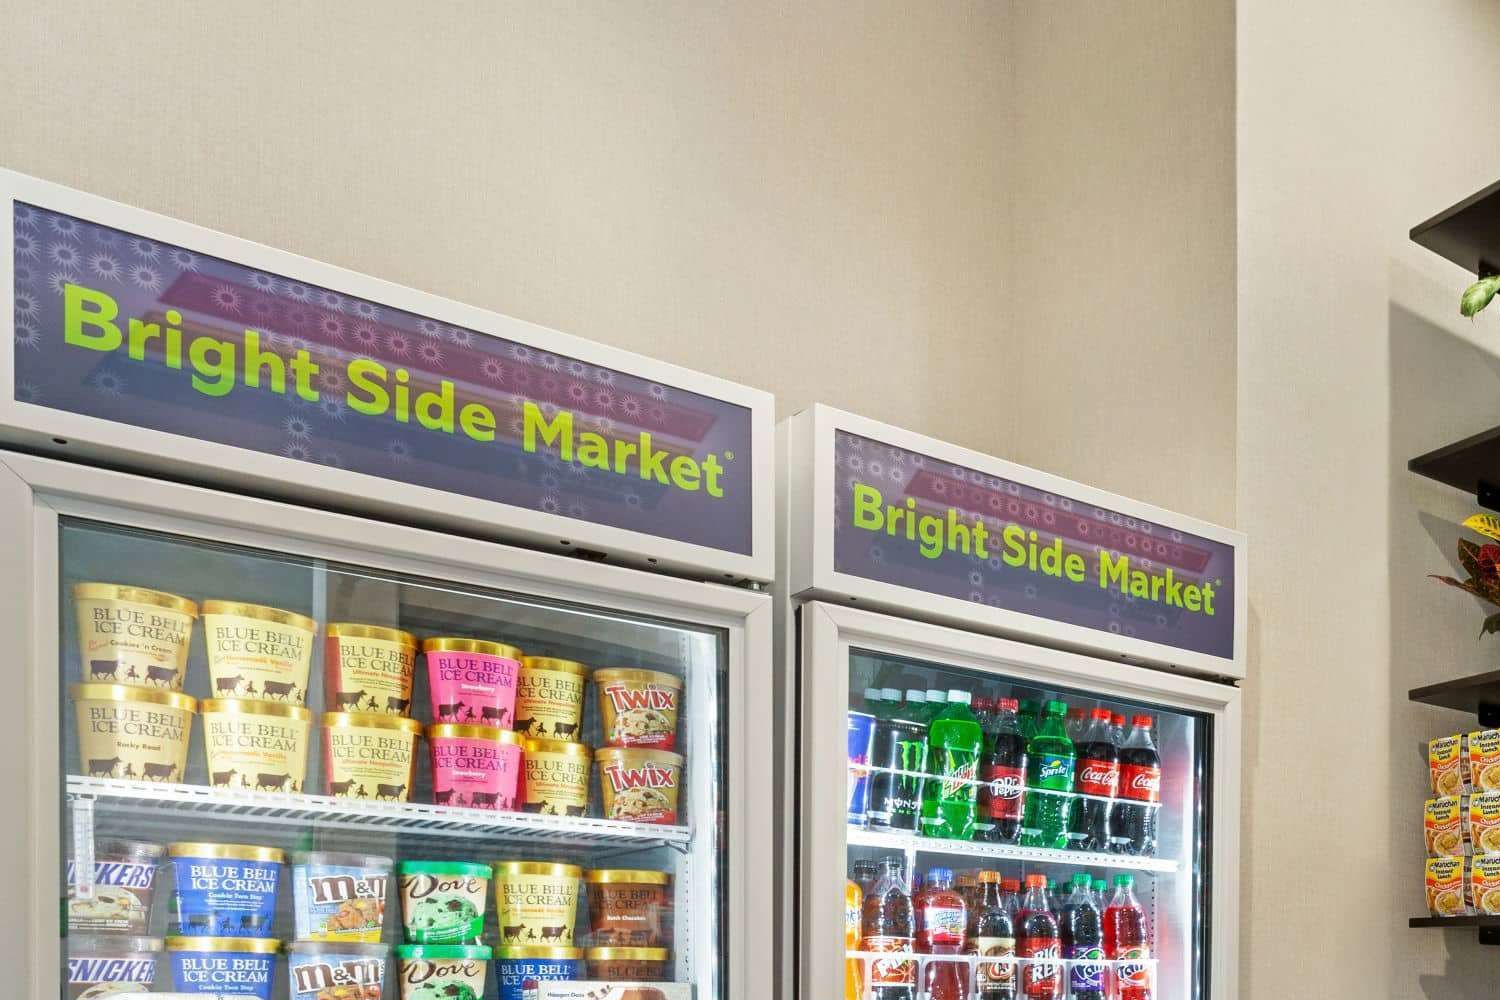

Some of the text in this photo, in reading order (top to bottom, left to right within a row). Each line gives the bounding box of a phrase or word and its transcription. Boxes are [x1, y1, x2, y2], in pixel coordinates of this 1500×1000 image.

[62, 281, 322, 402] Bright
[346, 358, 496, 442] Side
[853, 482, 989, 559] Bright
[1002, 524, 1085, 582] Side
[93, 607, 144, 624] BLUE
[95, 620, 185, 646] ICE CREAM
[216, 627, 300, 649] BLUE BELL
[217, 640, 301, 661] ICE CREAM
[439, 658, 513, 676] BLUE BELL
[440, 670, 512, 688] ICE CREAM
[92, 721, 118, 734] ICE
[1040, 766, 1068, 778] Sprite
[190, 865, 275, 880] BLUE BELL
[192, 879, 274, 893] ICE CREAM
[182, 958, 267, 971] BLUE BELL
[212, 971, 268, 983] CREAM
